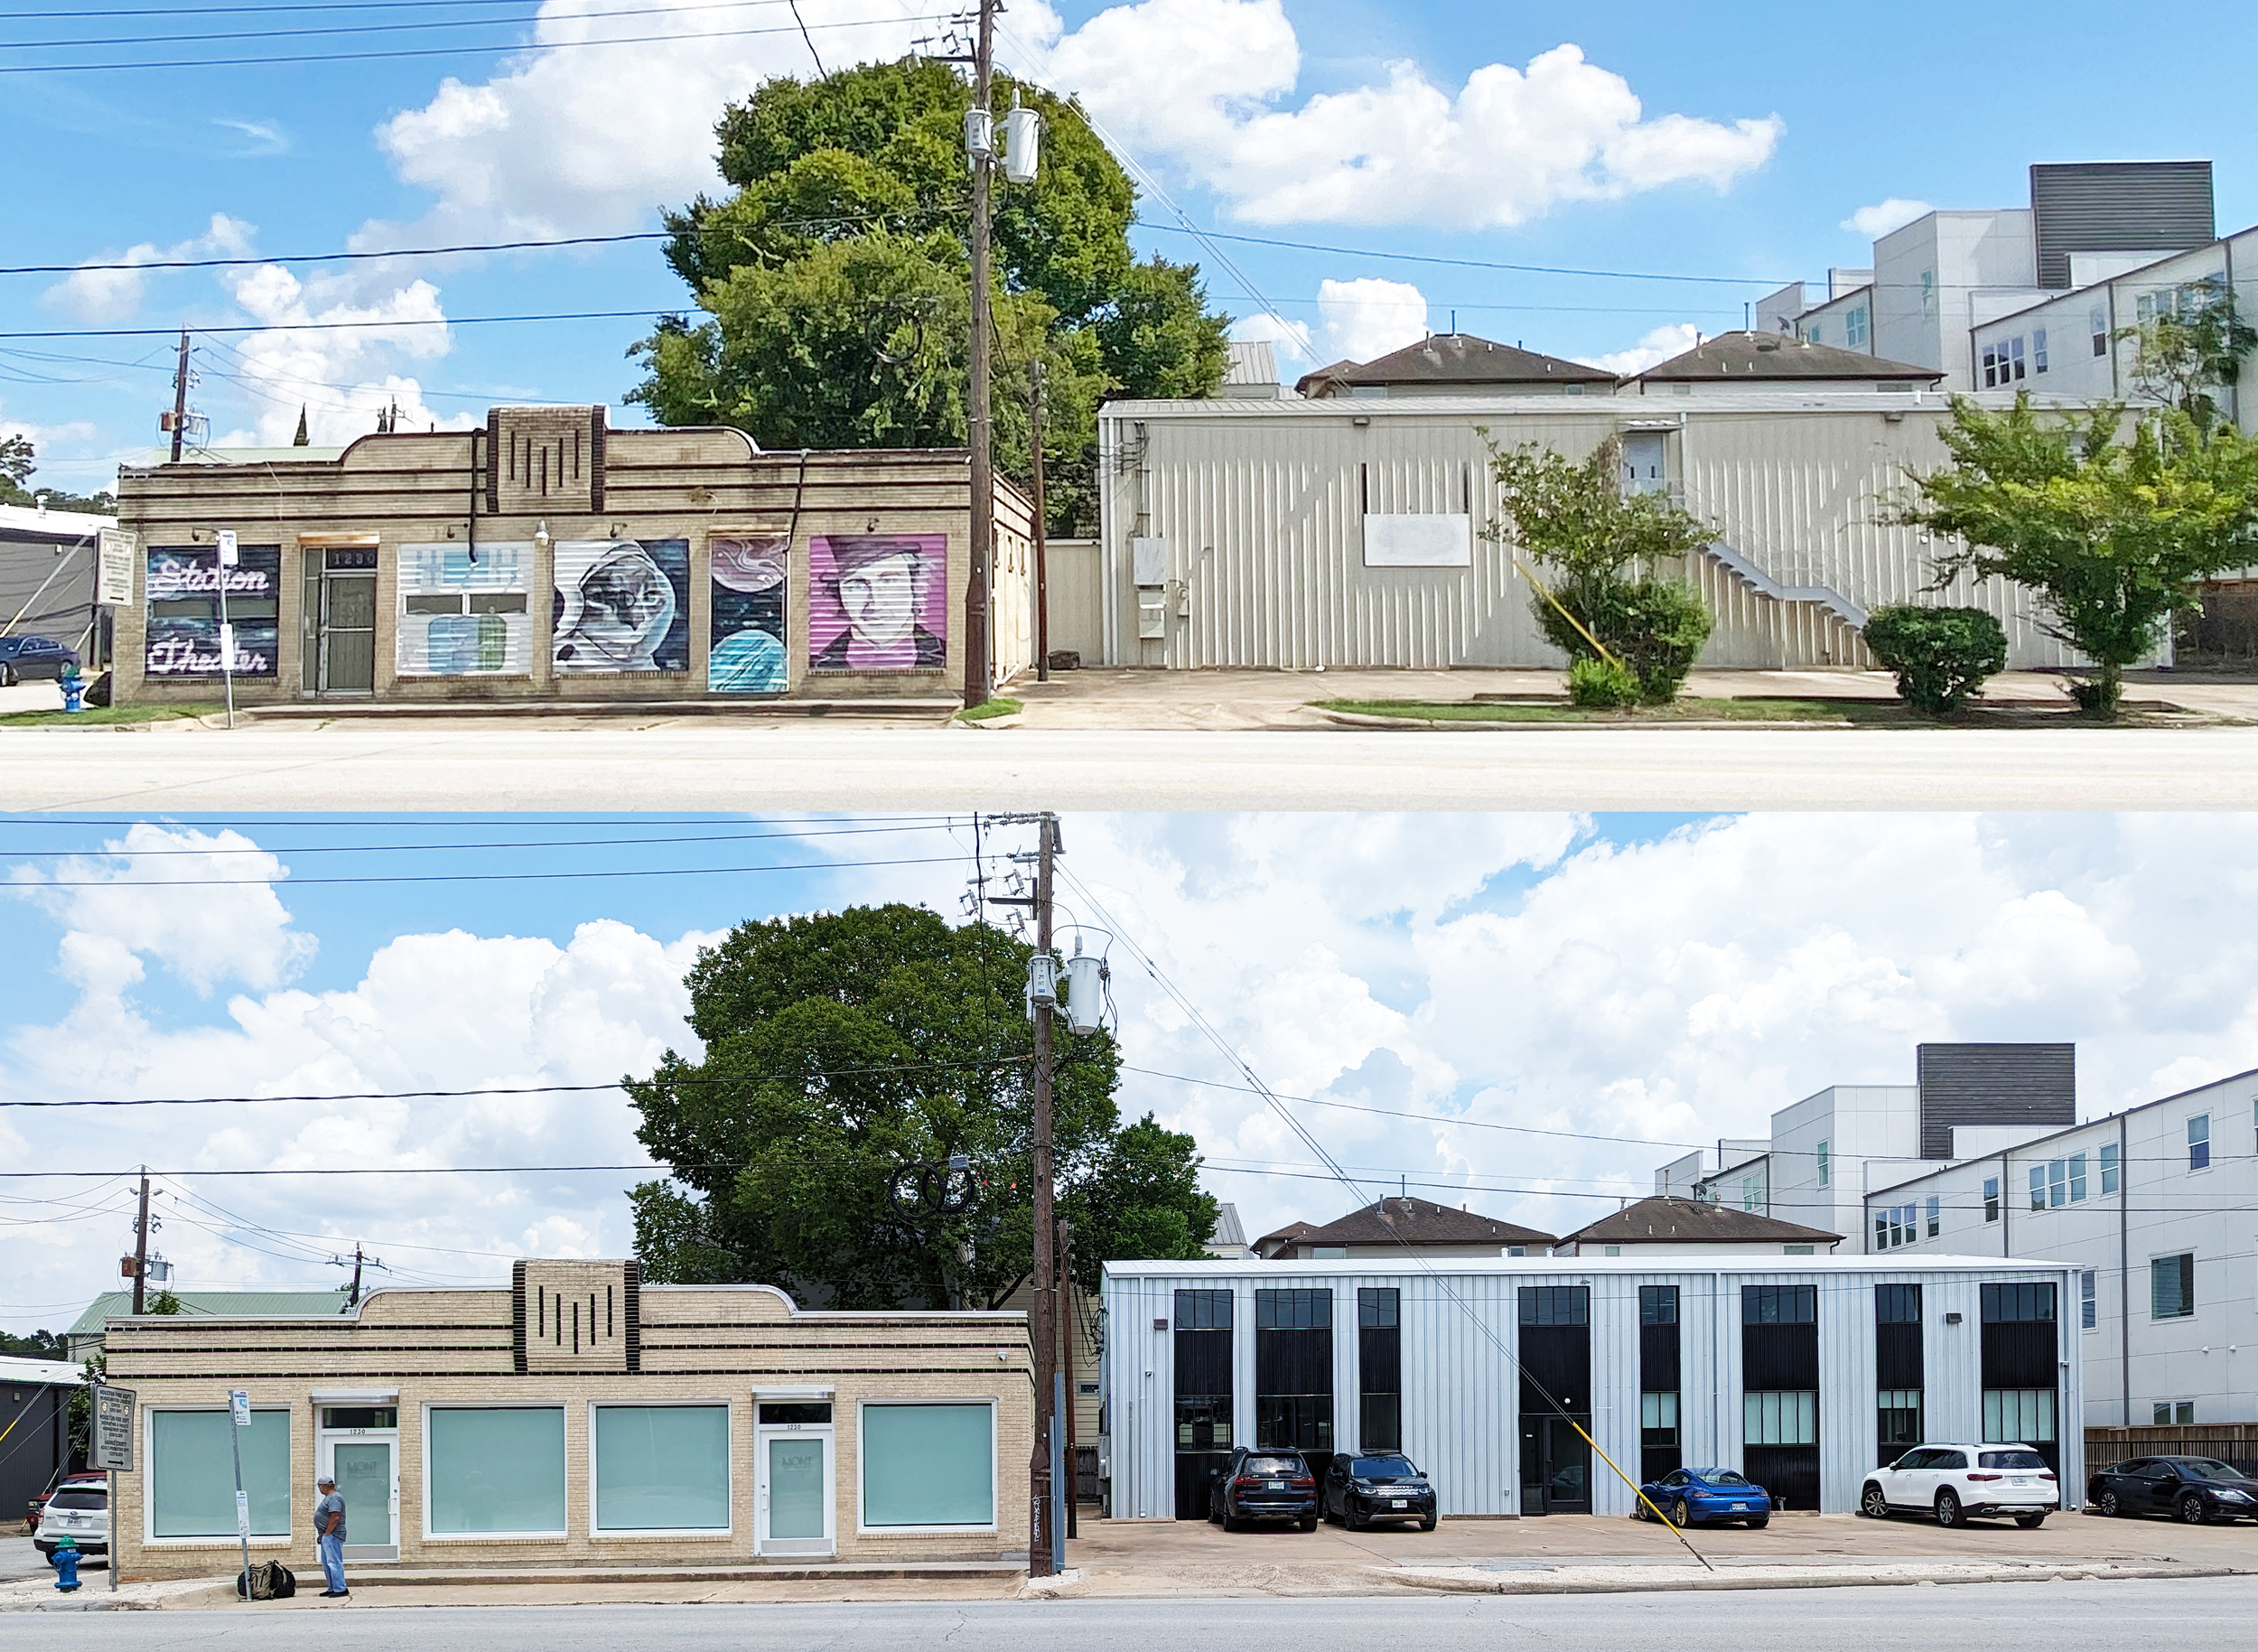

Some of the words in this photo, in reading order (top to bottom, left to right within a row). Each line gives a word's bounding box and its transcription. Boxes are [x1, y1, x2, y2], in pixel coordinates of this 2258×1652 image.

[334, 553, 376, 565] 1230
[147, 637, 267, 672] Theter
[347, 1461, 378, 1470] MONT
[782, 1456, 812, 1465] MONT
